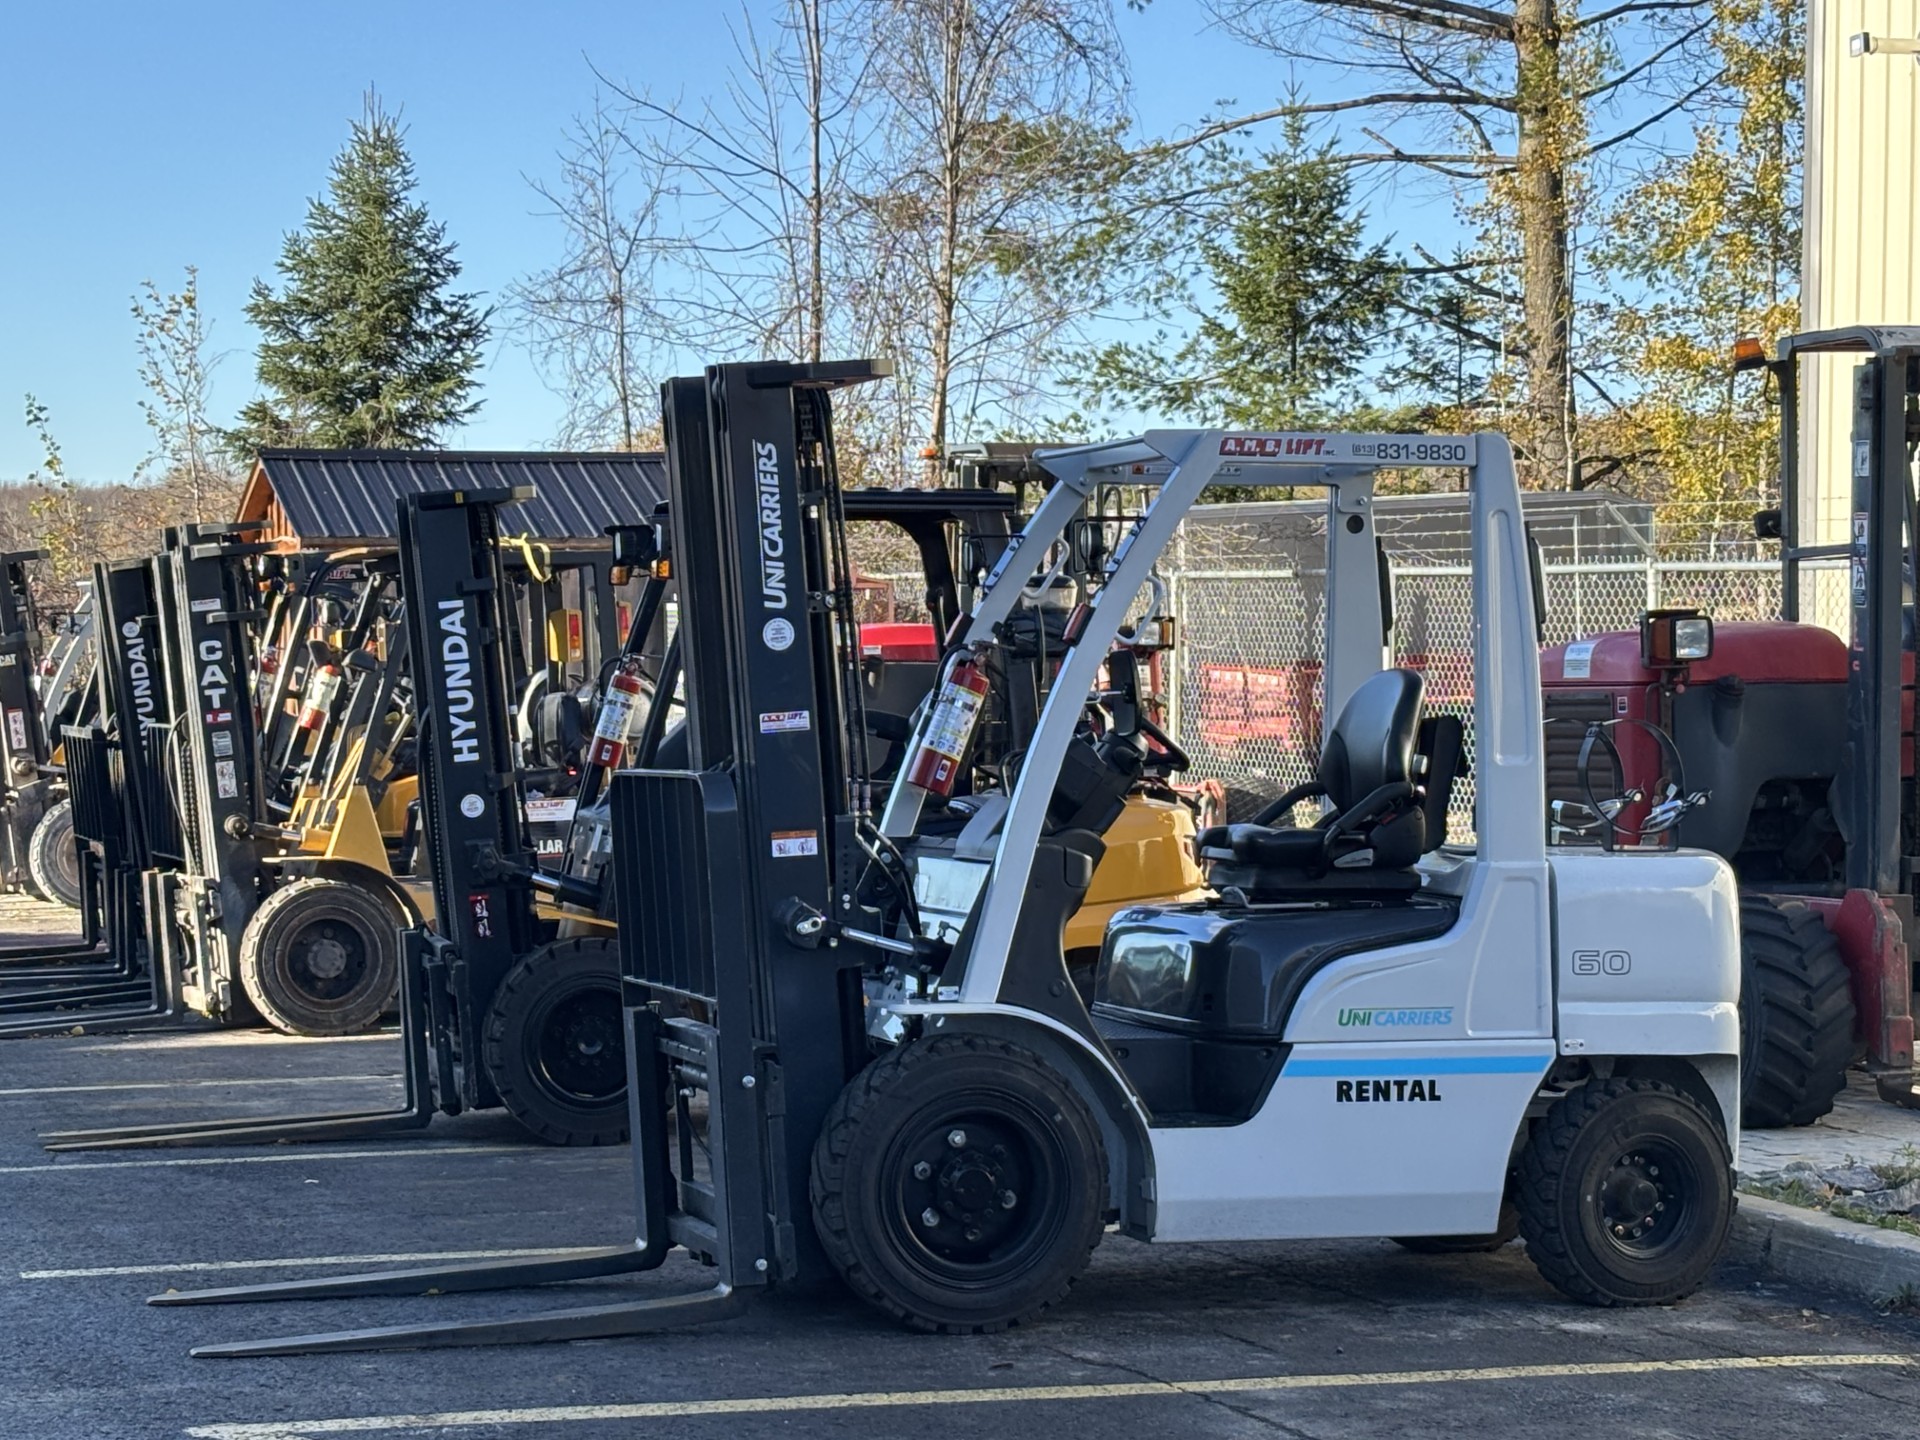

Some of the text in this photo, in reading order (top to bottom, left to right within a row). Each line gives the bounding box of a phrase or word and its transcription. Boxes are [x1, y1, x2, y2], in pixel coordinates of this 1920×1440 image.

[1285, 438, 1326, 455] LIFT
[1352, 443, 1466, 461] (613) 831-9830
[0, 653, 17, 667] CAT
[199, 639, 228, 709] CAT
[438, 599, 480, 763] HYUNDAI
[125, 637, 156, 746] YUNDAI
[1571, 949, 1632, 976] 60
[1336, 1079, 1441, 1103] RENTAL
